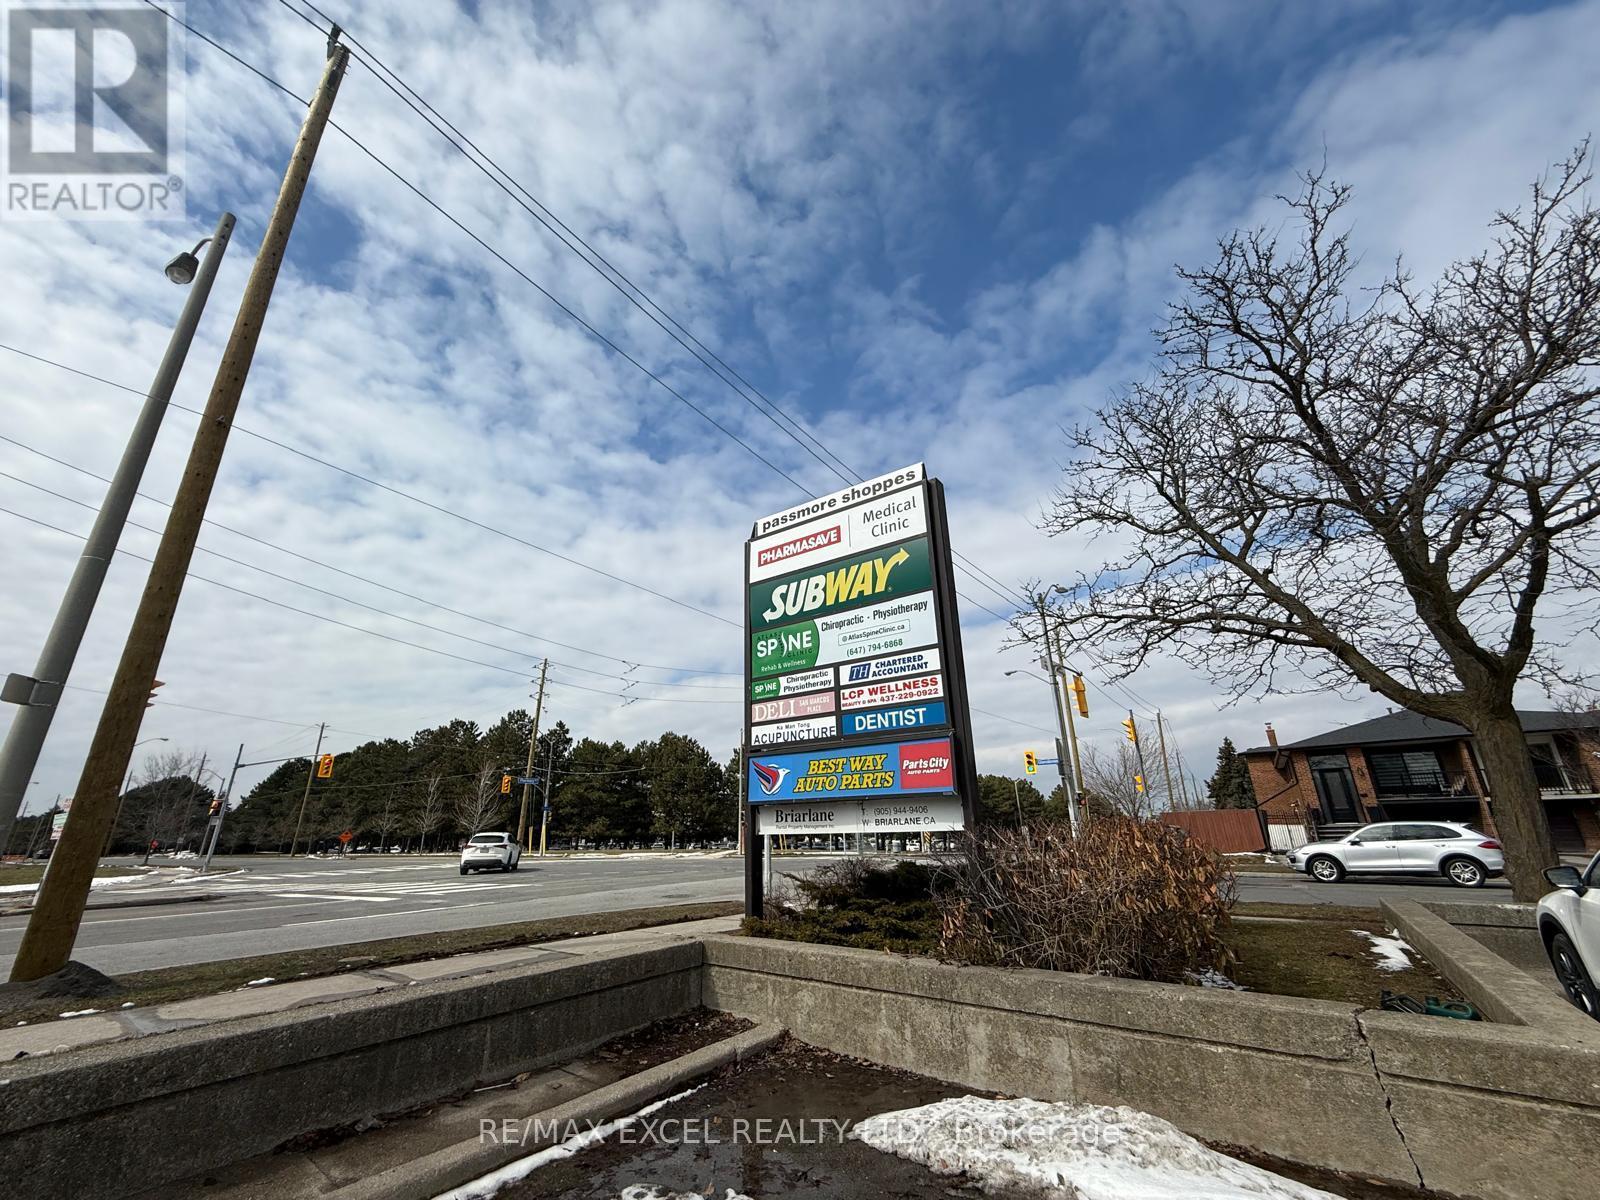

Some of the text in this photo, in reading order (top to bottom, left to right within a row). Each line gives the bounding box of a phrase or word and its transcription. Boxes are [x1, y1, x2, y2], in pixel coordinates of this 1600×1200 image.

[762, 470, 916, 533] passmore shoppes
[863, 496, 917, 524] Medical
[871, 517, 910, 538] Clinic
[760, 529, 838, 562] PHARMASAVE
[762, 548, 910, 623] SUBWAY
[821, 600, 928, 632] Chiropractic Physiotherapy
[847, 638, 903, 658] (647) 794-6868
[761, 664, 777, 672] Rehab
[783, 659, 806, 668] Wellness
[871, 662, 929, 678] ACCOUNTANT
[875, 654, 924, 669] CHARTERED
[783, 679, 832, 693] Physiotherapy
[786, 670, 829, 683] Chiropractic
[842, 677, 938, 701] LCP WELLNESS
[880, 688, 939, 703] 437-229-0922
[753, 700, 796, 721] DELI
[855, 708, 926, 731] DENTIST
[753, 726, 836, 745] ACUPUNCTURE
[807, 753, 888, 775] BEST WAY
[793, 771, 895, 793] AUTO PARTS
[775, 808, 834, 823] Briarlane
[874, 807, 891, 817] (905)
[893, 805, 929, 815] 944-9406
[875, 816, 936, 826] BRIARLANE.CA
